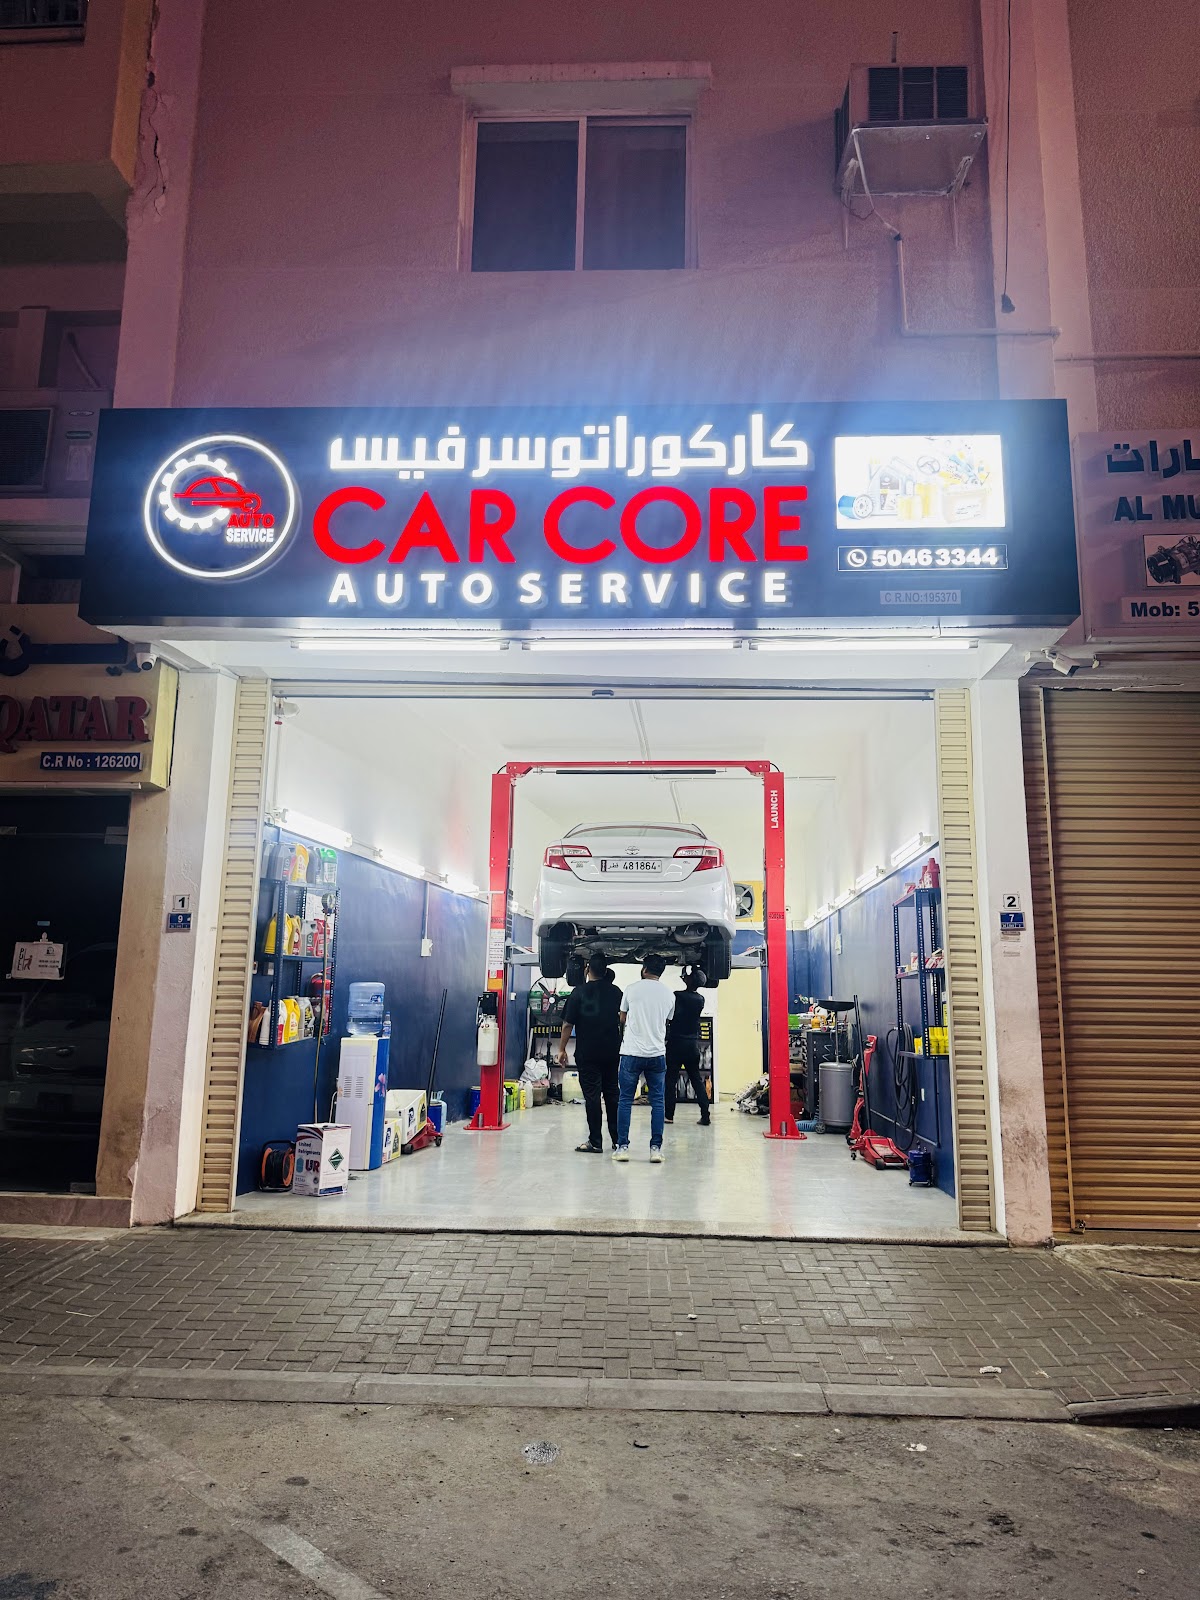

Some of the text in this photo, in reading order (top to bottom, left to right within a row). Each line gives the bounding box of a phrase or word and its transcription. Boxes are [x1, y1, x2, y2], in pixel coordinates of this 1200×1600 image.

[1114, 496, 1153, 522] AL
[226, 513, 275, 528] AUTO
[312, 485, 809, 564] CAR CORE
[225, 528, 275, 543] SERVICE
[328, 571, 789, 604] AUTO SERVICE
[1130, 601, 1181, 618] Mob:
[66, 755, 84, 768] No
[94, 755, 139, 768] 126200
[770, 789, 779, 829] LAUNCH
[622, 861, 657, 870] 481864
[178, 896, 186, 908] 1
[1007, 896, 1017, 908] 2
[177, 915, 184, 923] 9
[1009, 914, 1015, 922] 7
